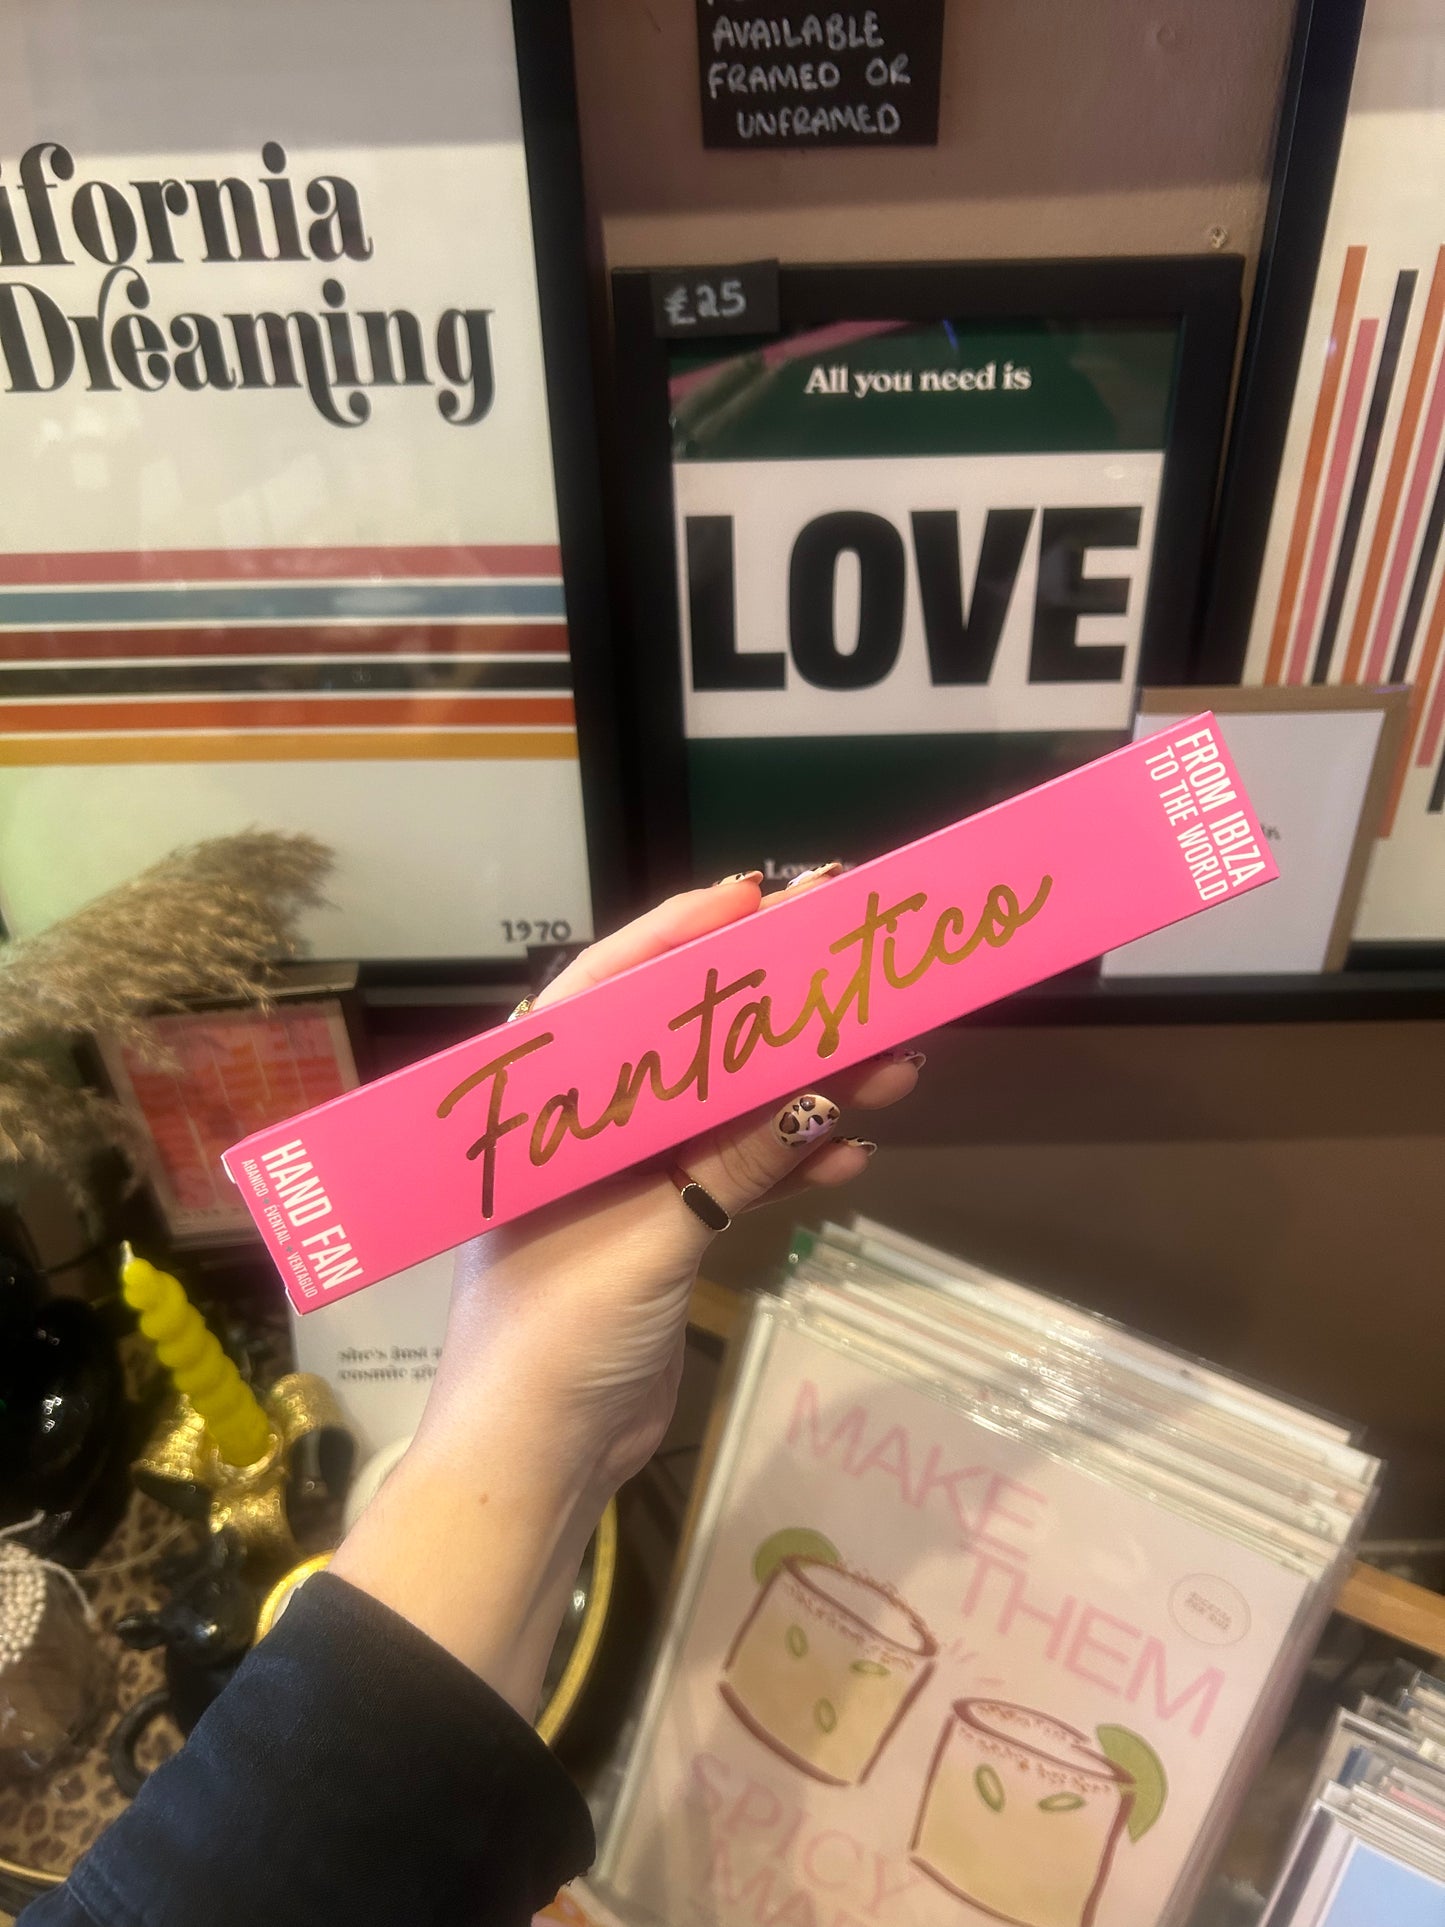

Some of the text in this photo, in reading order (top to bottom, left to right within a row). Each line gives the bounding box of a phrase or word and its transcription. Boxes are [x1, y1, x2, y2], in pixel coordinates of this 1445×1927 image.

[707, 53, 911, 99] FRAMED OR
[712, 10, 885, 52] AVAILABLE
[736, 102, 901, 138] UNFRAMED
[0, 265, 496, 428] Dreaming
[664, 280, 748, 327] £25
[803, 360, 1033, 398] All you need is
[685, 506, 1143, 692] LOVE
[1145, 745, 1229, 901] TO THE WORLD
[1174, 728, 1267, 887] FROM IBIZA
[501, 919, 572, 943] 1970
[436, 875, 1054, 1220] Fantastico
[241, 1159, 319, 1298] ABANICO ÉVENTAIL VENTAGLIO
[261, 1138, 364, 1290] HAND FAN
[787, 1379, 1049, 1563] MAKE
[959, 1541, 1227, 1738] THEM
[680, 1751, 926, 1917] SPICY
